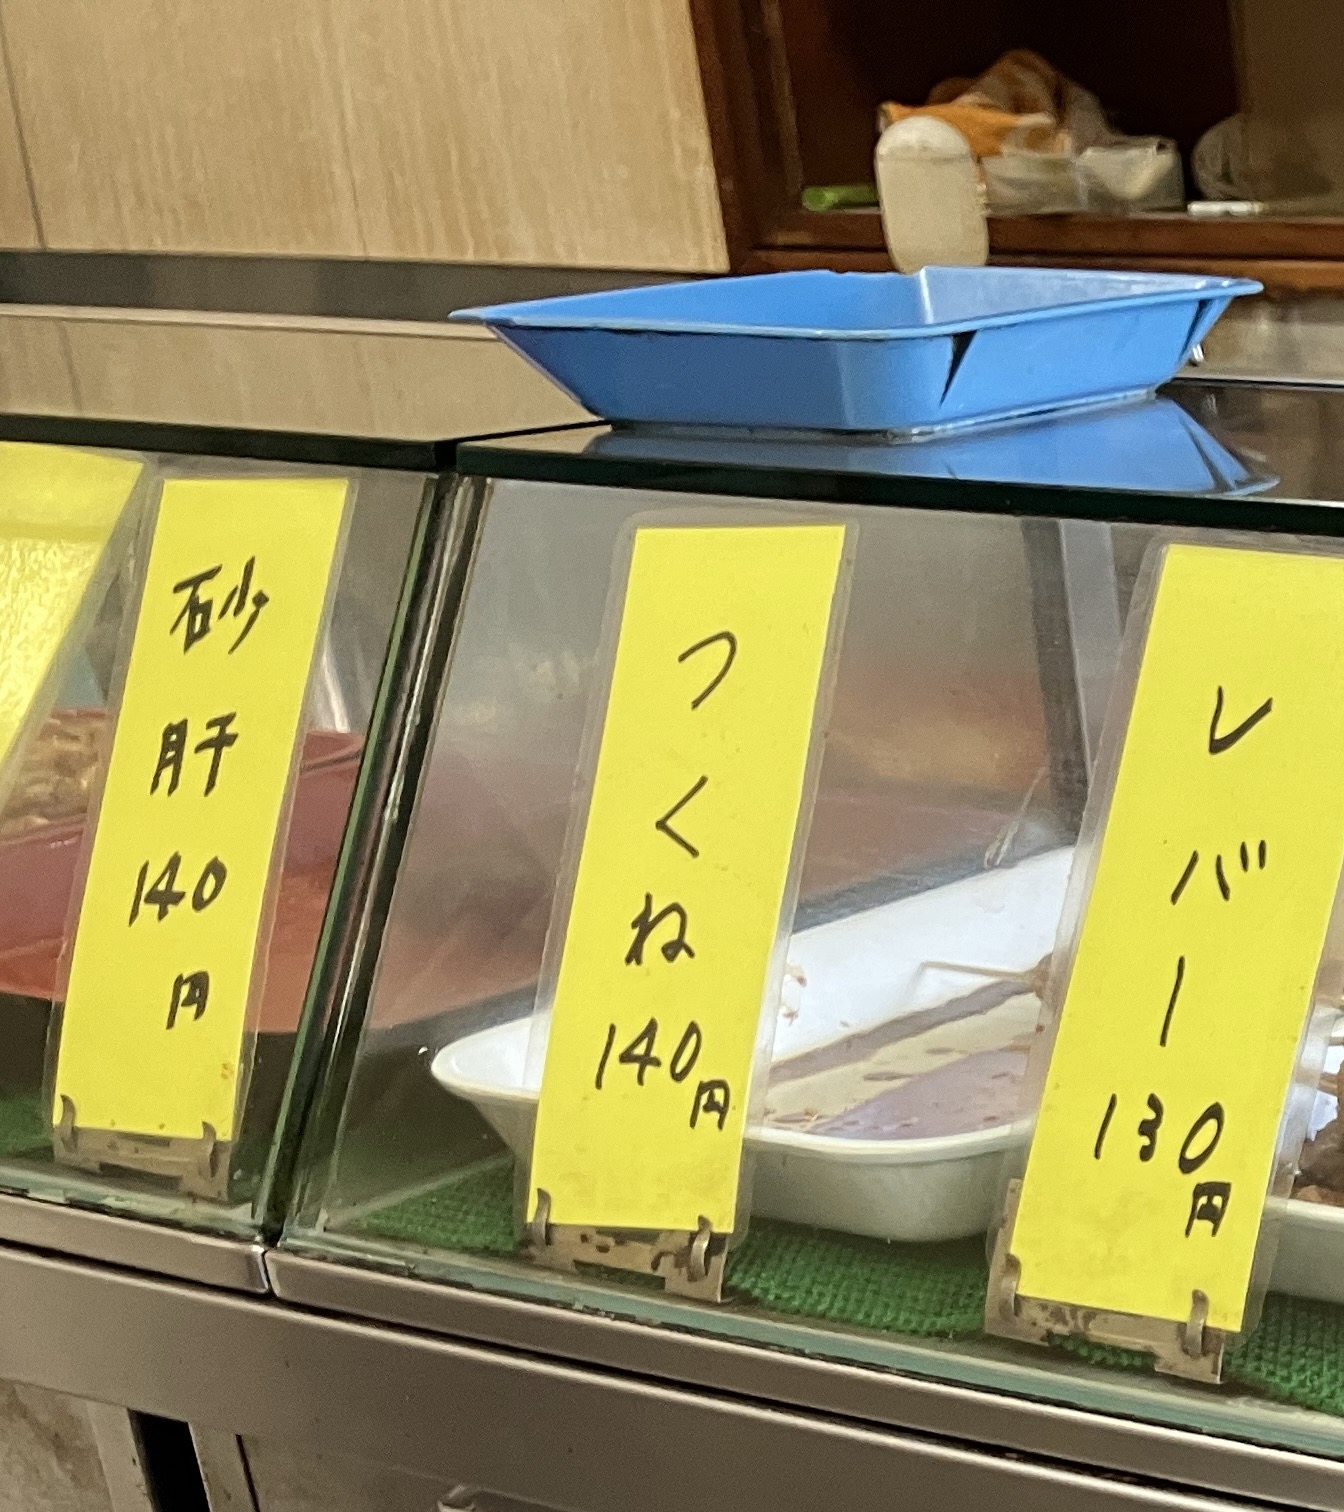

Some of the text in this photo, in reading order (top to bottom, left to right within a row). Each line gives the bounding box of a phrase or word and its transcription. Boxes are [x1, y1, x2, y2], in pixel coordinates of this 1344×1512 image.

[150, 555, 269, 797] 砂肝
[625, 631, 737, 965] つくね
[1160, 686, 1272, 1047] レバー
[129, 852, 227, 1029] 140円
[595, 1018, 730, 1130] 140円
[1094, 1094, 1231, 1238] 130円
